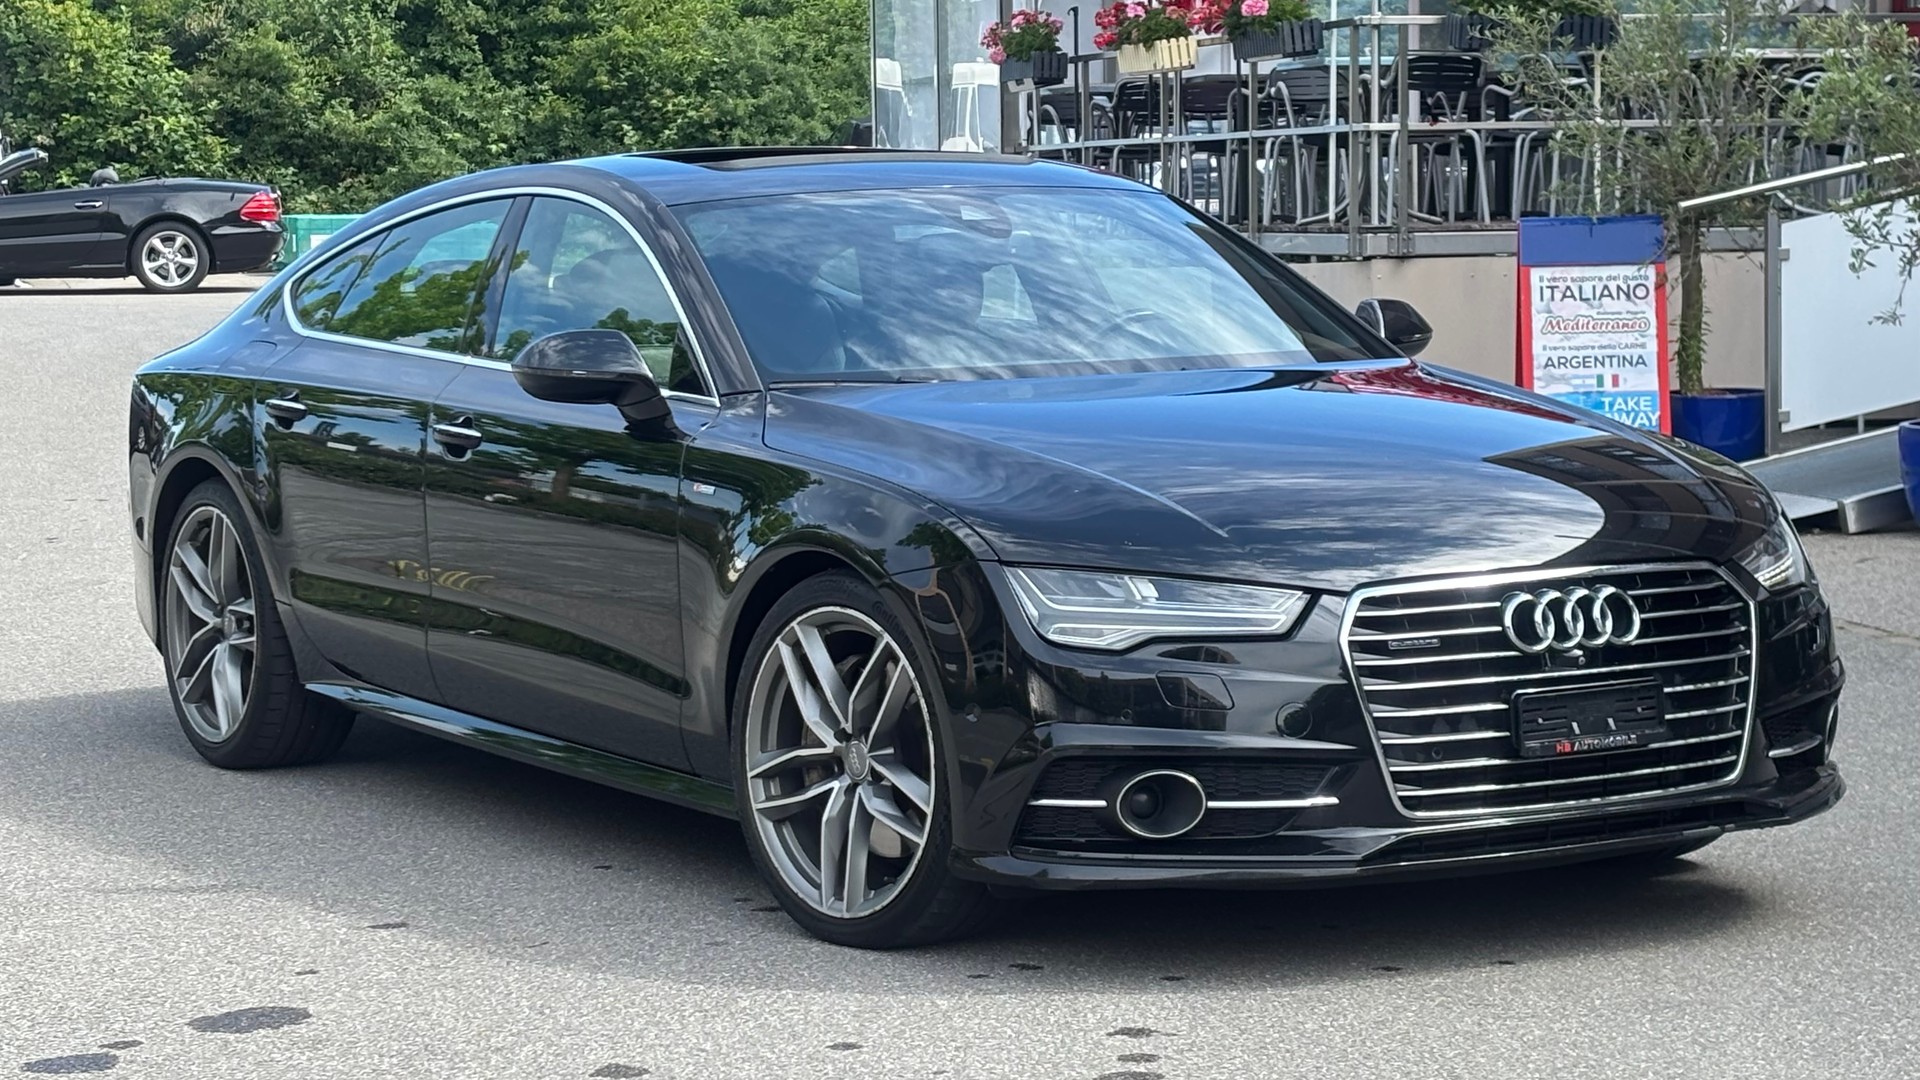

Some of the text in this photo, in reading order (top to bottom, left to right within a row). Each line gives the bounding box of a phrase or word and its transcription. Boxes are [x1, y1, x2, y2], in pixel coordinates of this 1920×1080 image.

[1546, 275, 1568, 283] vero
[1570, 275, 1603, 284] sapore
[1605, 273, 1620, 281] del
[1622, 273, 1649, 284] gusto
[1539, 283, 1650, 302] ITALIANO
[1543, 317, 1649, 333] Mediterraneo
[1568, 344, 1596, 352] sapore
[1543, 354, 1648, 370] ARGENTINA
[1600, 396, 1652, 412] TAKE
